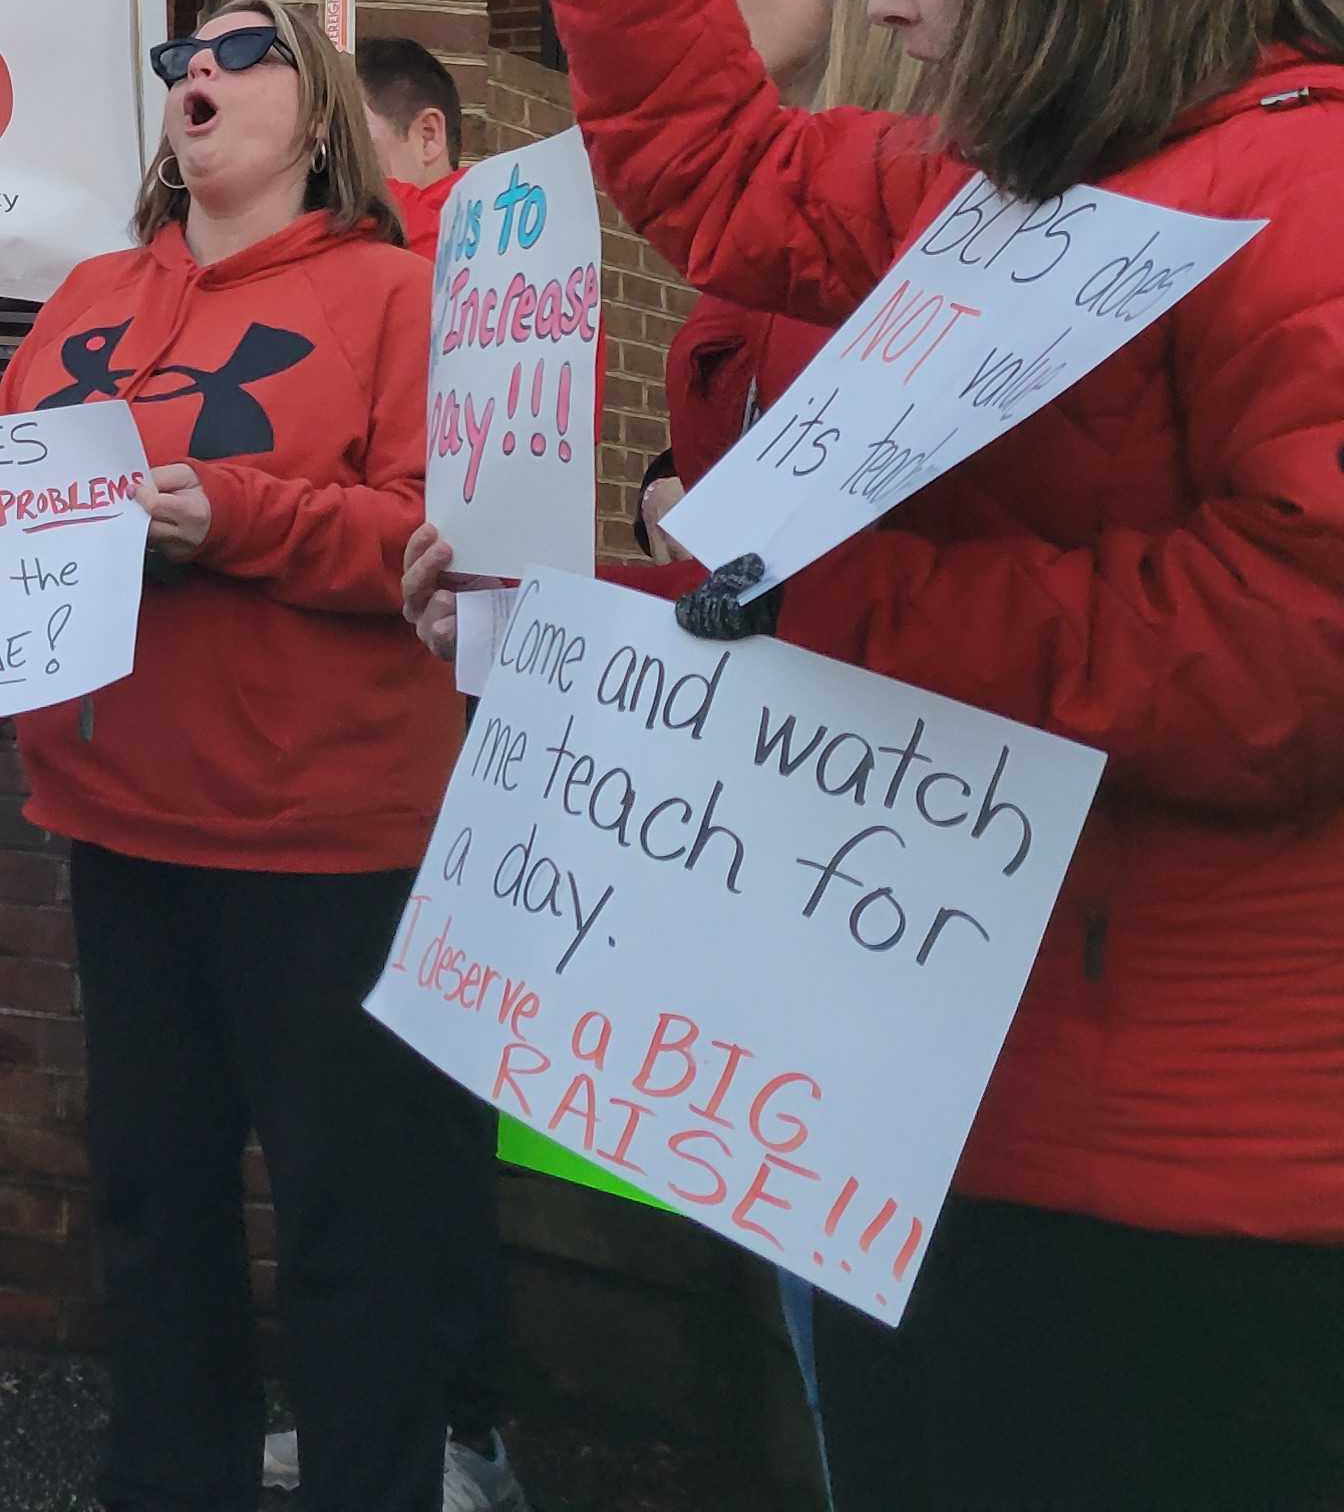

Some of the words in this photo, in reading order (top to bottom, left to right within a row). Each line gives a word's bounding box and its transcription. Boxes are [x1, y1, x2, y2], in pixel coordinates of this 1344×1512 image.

[494, 163, 547, 256] to
[442, 262, 599, 355] Increase
[840, 279, 981, 386] NOT
[9, 556, 80, 595] the
[499, 578, 586, 694] Come
[596, 647, 731, 741] and
[753, 705, 1033, 877] watch
[442, 828, 472, 886] a
[493, 824, 617, 975] day.
[471, 716, 528, 791] me
[543, 714, 745, 894] teach
[795, 825, 990, 966] for
[391, 895, 433, 973] I
[418, 915, 541, 1039] deserve
[571, 1011, 612, 1070] a
[632, 1011, 823, 1154] BIG
[491, 1043, 923, 1306] RAISE!!!
